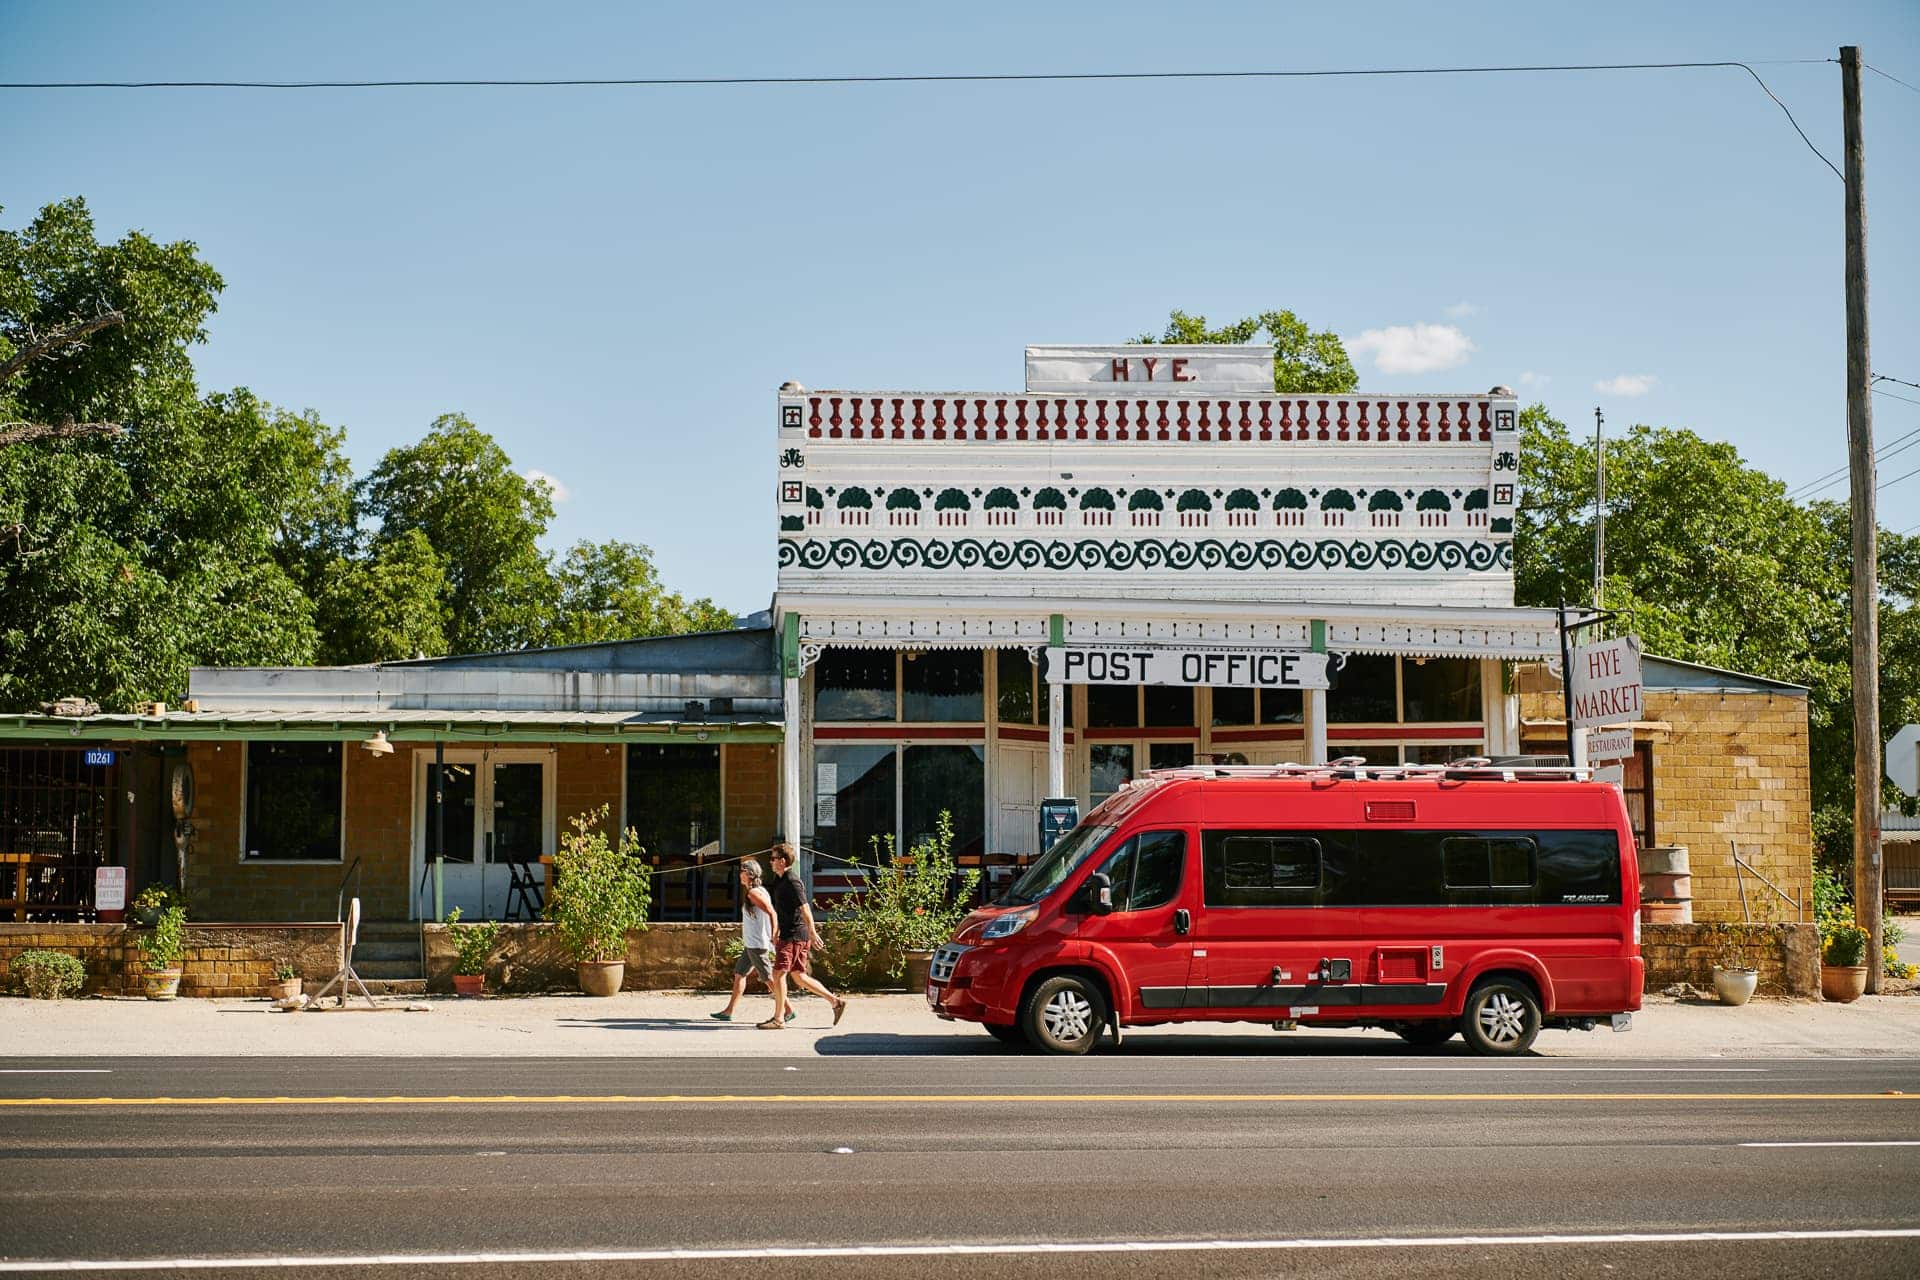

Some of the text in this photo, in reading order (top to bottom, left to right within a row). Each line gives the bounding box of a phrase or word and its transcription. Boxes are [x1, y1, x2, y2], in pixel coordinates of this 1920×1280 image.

[1064, 651, 1301, 685] POST OFFICE
[1588, 648, 1621, 680] HYE
[1574, 683, 1640, 721] MARKET
[87, 752, 110, 765] 10261
[1587, 736, 1631, 753] RESTAURANT
